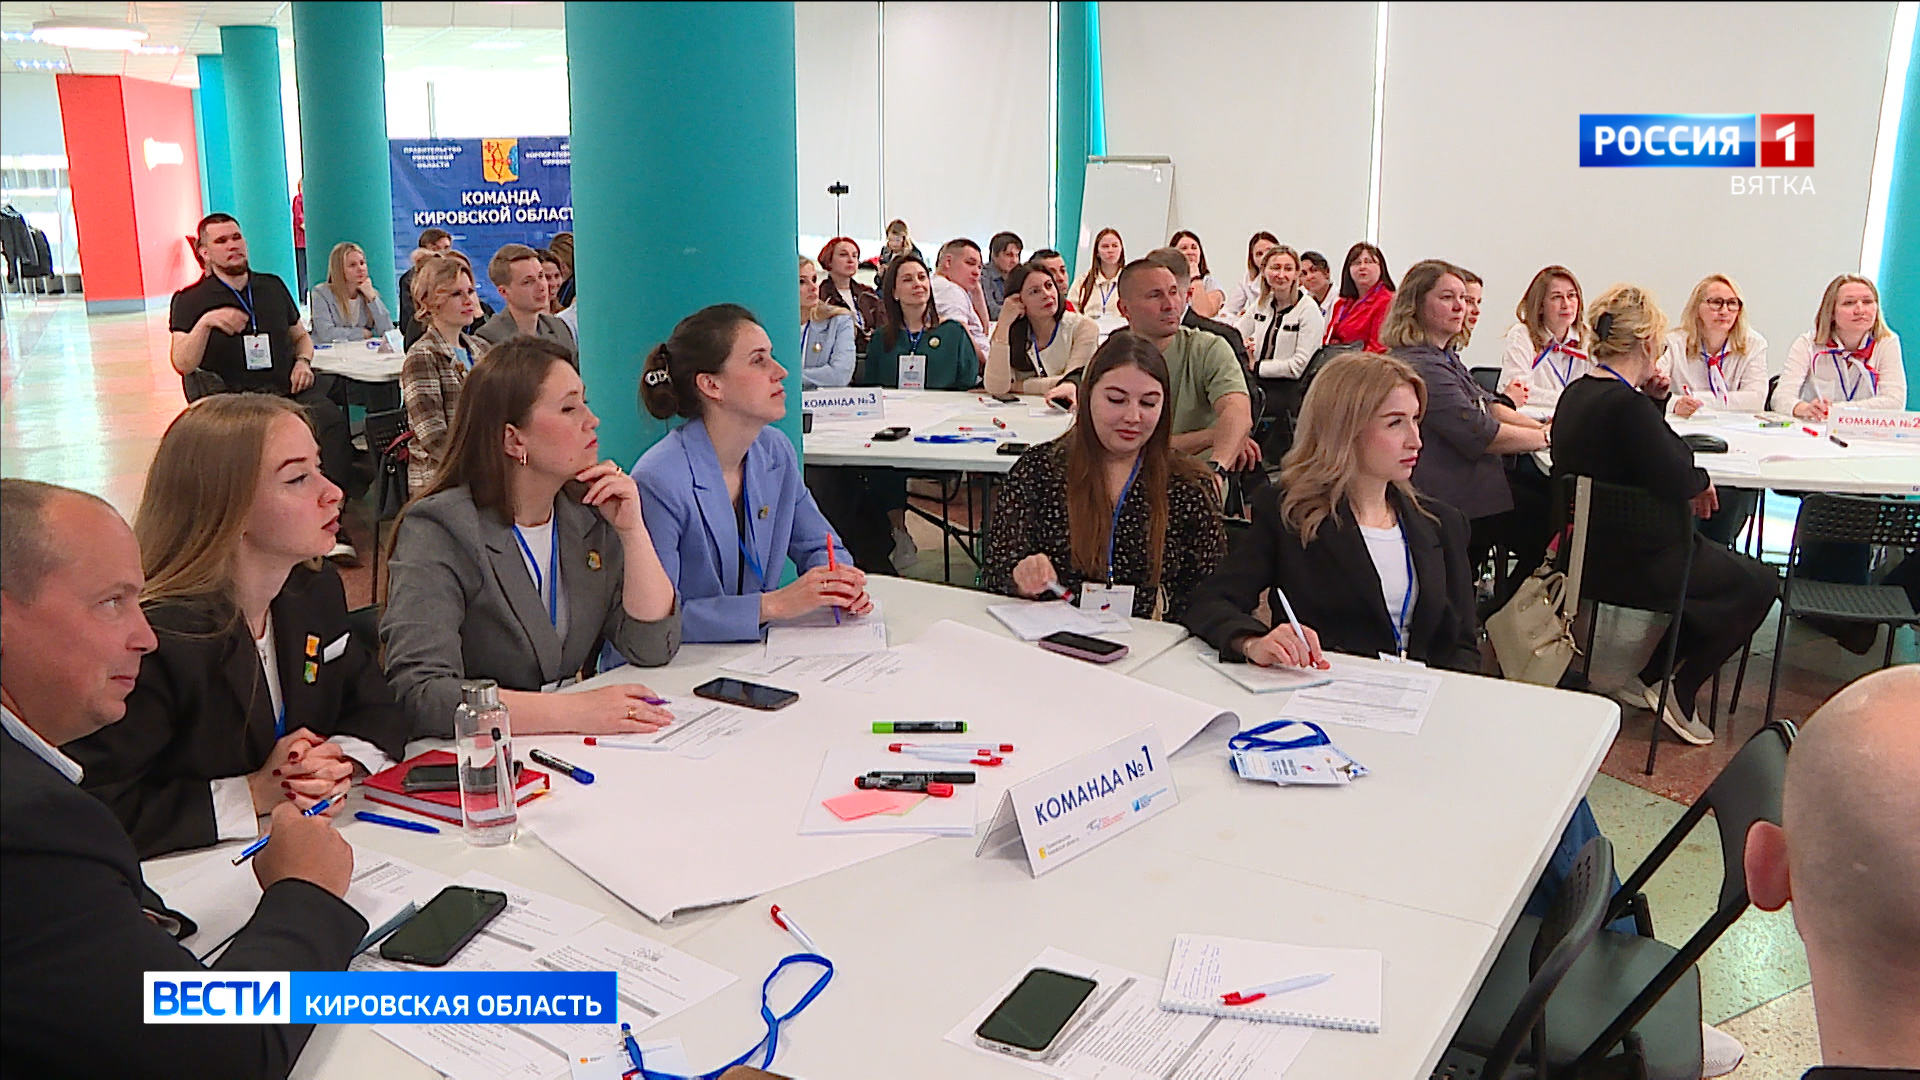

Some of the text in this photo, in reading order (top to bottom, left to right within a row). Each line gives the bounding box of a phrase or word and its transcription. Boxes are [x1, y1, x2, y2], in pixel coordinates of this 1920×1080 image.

[462, 189, 541, 206] КОМАНДА
[414, 206, 511, 226] КИРОВСКОЙ
[804, 397, 855, 408] КОМАНДА
[1838, 417, 1896, 428] КОМАНДА
[1034, 768, 1125, 826] КОМАНДА
